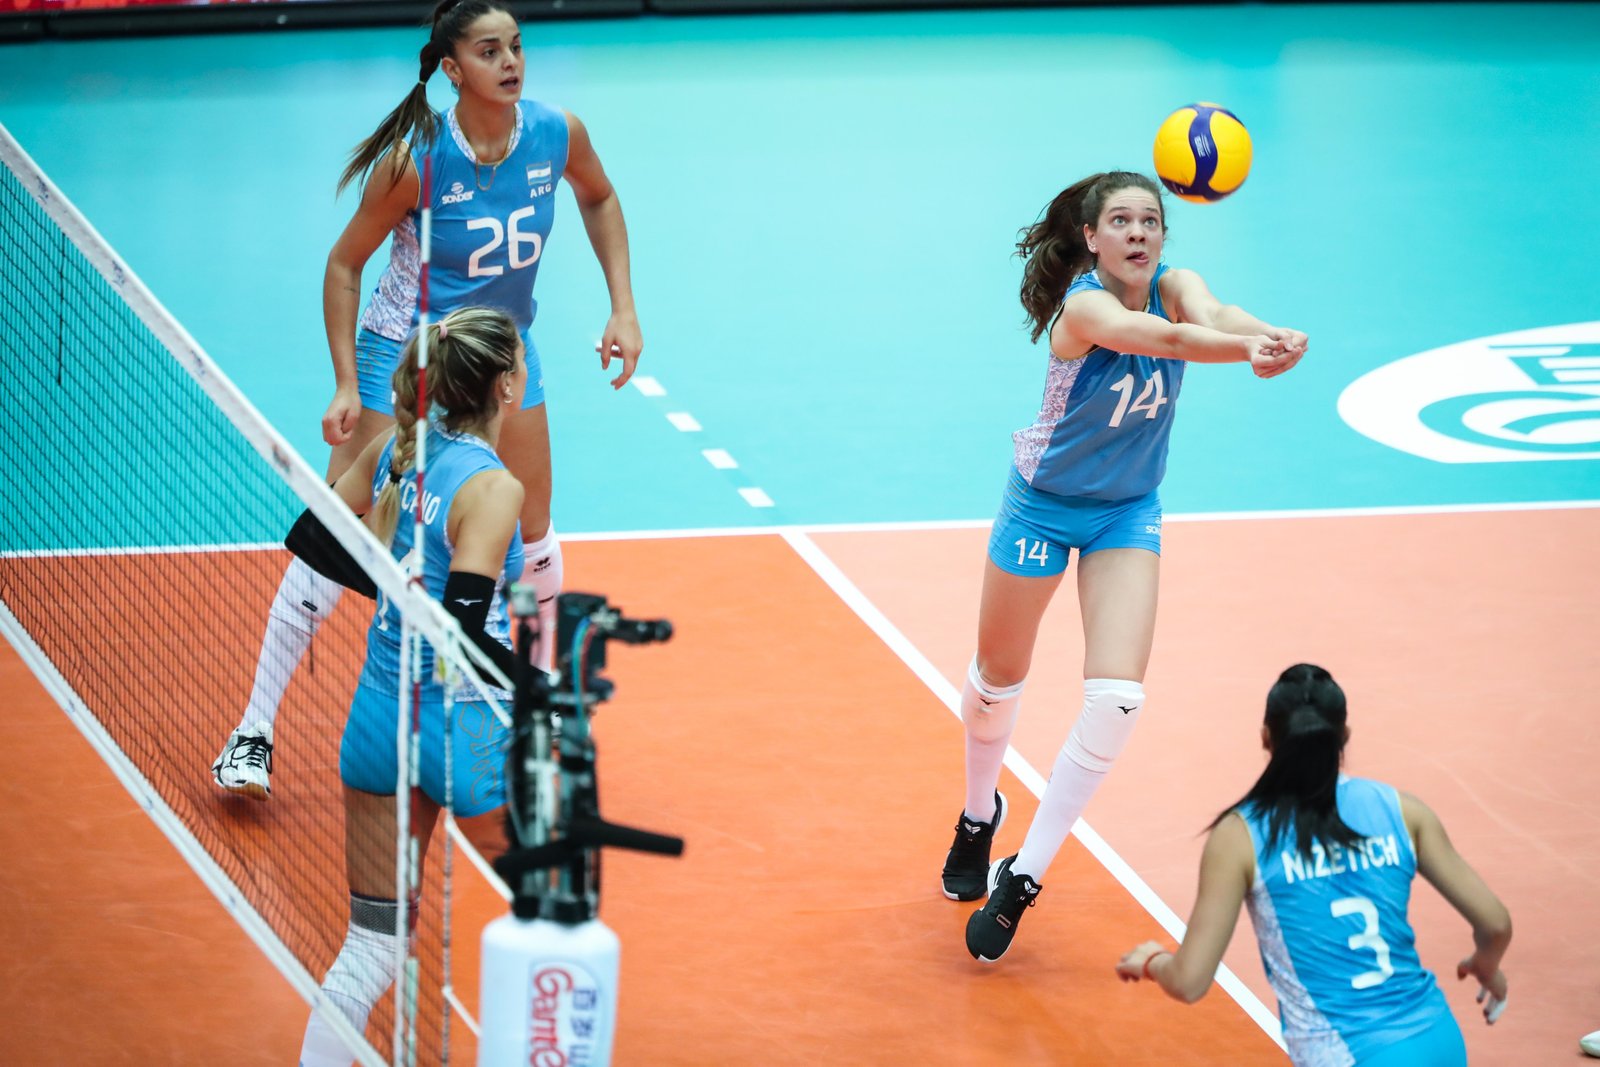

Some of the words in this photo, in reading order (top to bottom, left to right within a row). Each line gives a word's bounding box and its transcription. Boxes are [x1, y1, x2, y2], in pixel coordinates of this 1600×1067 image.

[530, 183, 552, 199] ARG
[466, 205, 542, 278] 26
[1108, 369, 1168, 428] 14
[1015, 537, 1049, 567] 14
[1330, 896, 1394, 989] 3
